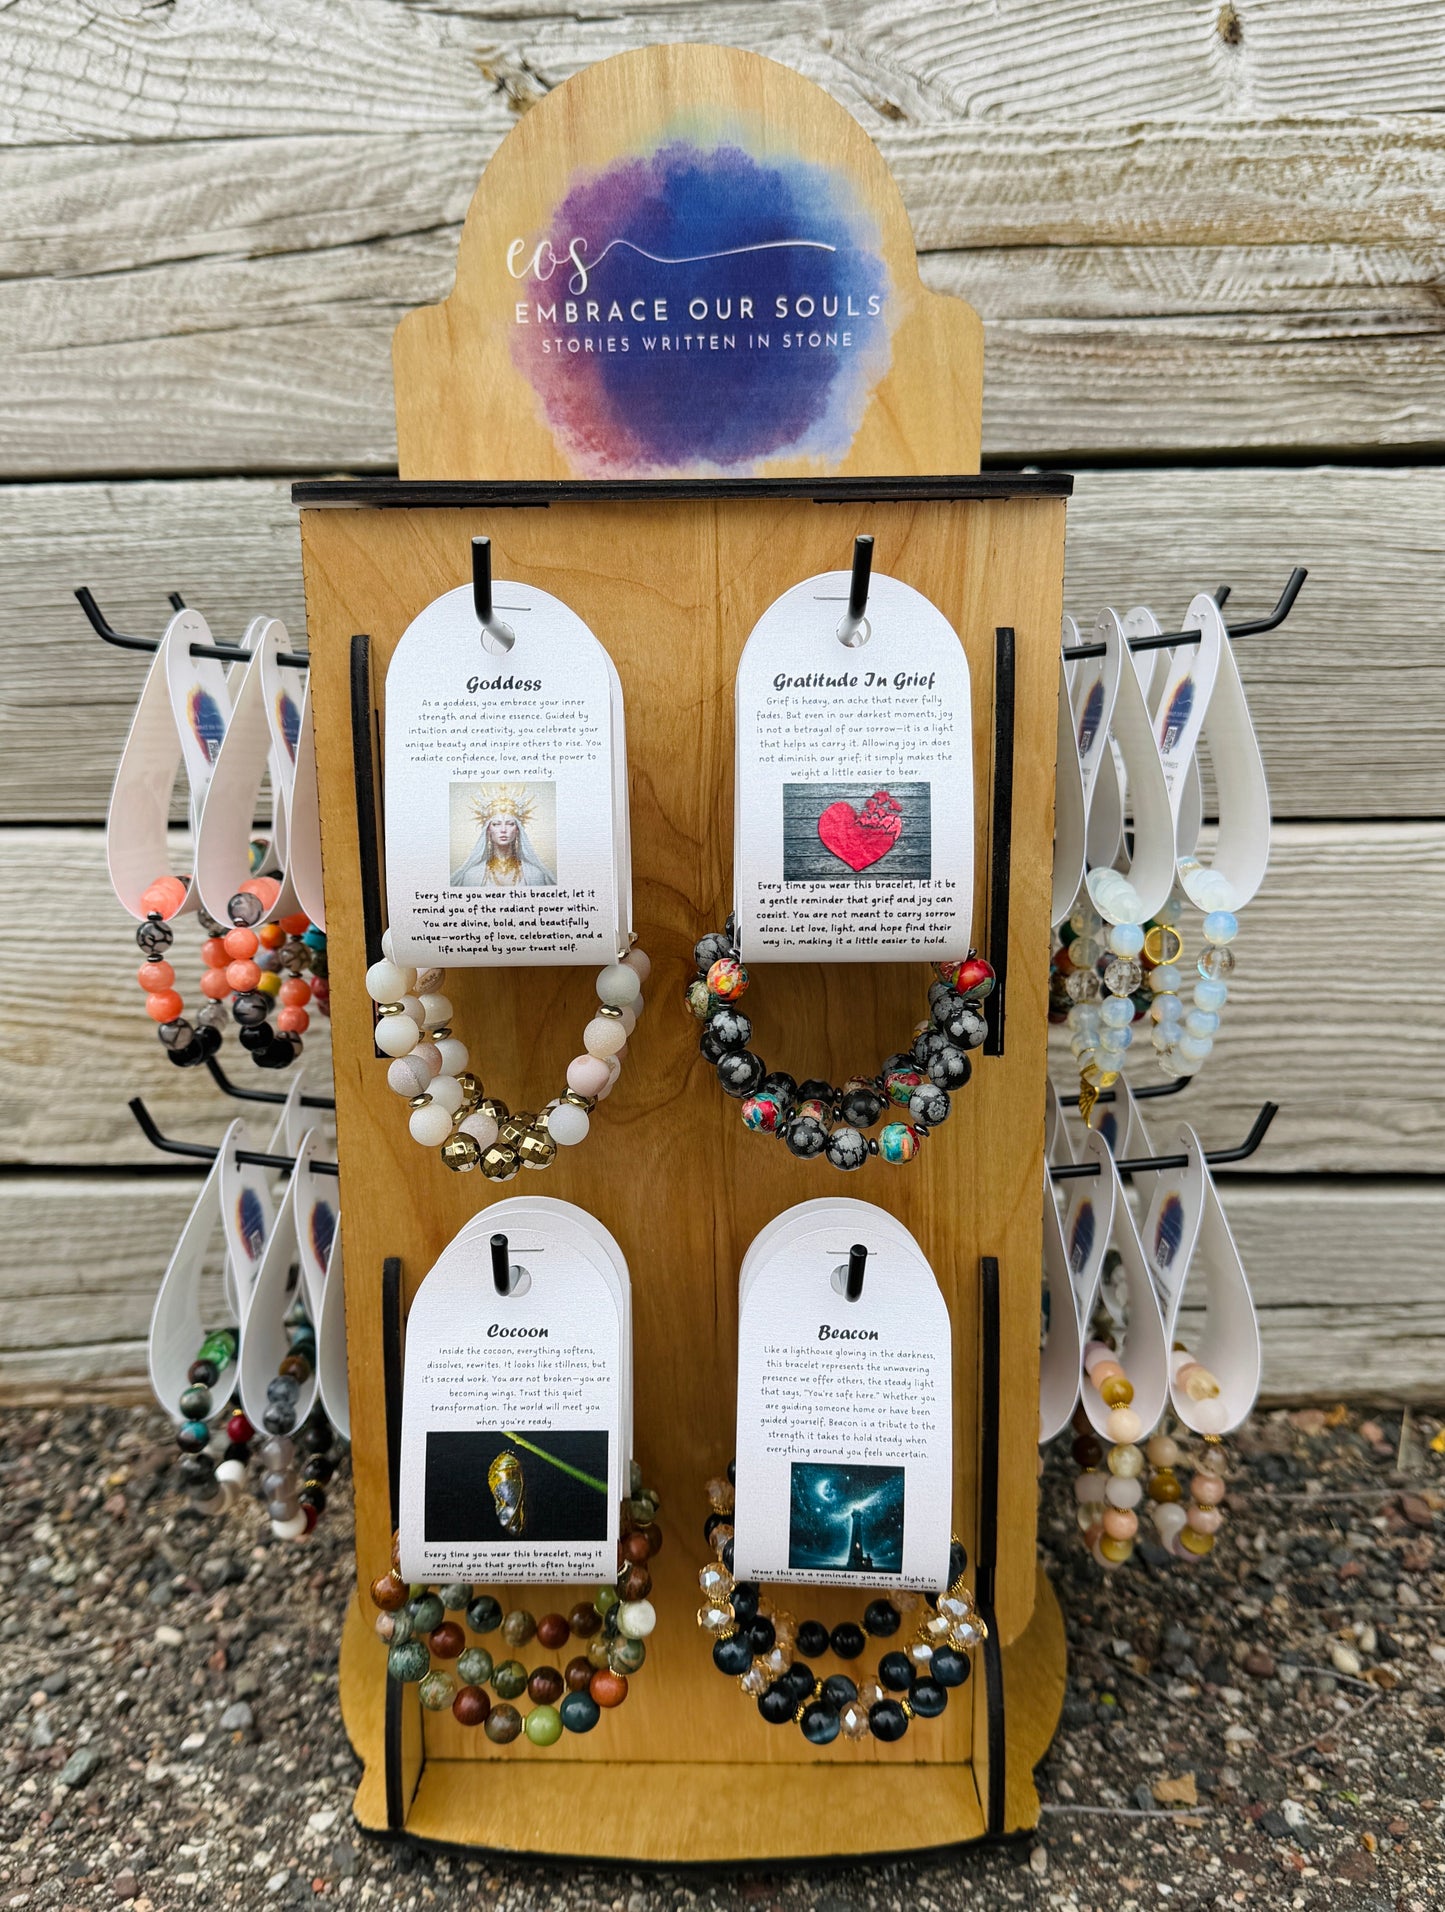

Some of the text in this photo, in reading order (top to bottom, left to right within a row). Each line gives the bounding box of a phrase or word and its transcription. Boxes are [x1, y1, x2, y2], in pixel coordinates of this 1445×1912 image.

[506, 235, 589, 296] eos
[515, 295, 881, 325] EMBRACE OUR SOULS
[542, 333, 853, 354] STORIES WRITTEN IN STONE
[466, 675, 542, 694] Goddess
[773, 672, 935, 691] Gratitude In Grief
[422, 699, 432, 707] As
[443, 698, 479, 710] goddess,
[481, 701, 497, 710] you
[500, 698, 537, 706] embrace
[539, 700, 559, 709] your
[418, 712, 457, 724] strength
[459, 712, 477, 720] and
[480, 712, 506, 720] divine
[545, 711, 575, 720] Guided
[578, 710, 589, 723] by
[756, 710, 783, 721] fades.
[786, 711, 801, 719] But
[857, 709, 891, 718] darkest
[894, 710, 937, 718] moments,
[938, 710, 953, 721] joy
[415, 891, 439, 903] Every
[442, 891, 463, 900] time
[466, 893, 482, 903] you
[509, 890, 527, 899] this
[530, 889, 570, 899] bracelet,
[572, 889, 585, 898] let
[588, 889, 595, 898] it
[769, 895, 798, 908] gentle
[801, 895, 844, 904] reminder
[846, 895, 868, 904] that
[871, 894, 895, 907] grief
[896, 895, 916, 903] and
[916, 895, 932, 907] joy
[412, 903, 599, 917] remind you of the radiant power within.
[756, 910, 790, 919] coexist.
[792, 911, 810, 919] You
[831, 910, 847, 919] not
[851, 910, 881, 918] meant
[883, 910, 894, 918] to
[897, 912, 922, 922] carry
[422, 920, 440, 928] You
[460, 919, 491, 928] divine,
[493, 918, 516, 928] bold,
[518, 918, 537, 927] and
[540, 917, 589, 929] beautifully
[759, 922, 952, 935] alone. Let love, light, and hope find their
[438, 943, 578, 955] life shaped by your truest self.
[487, 1324, 549, 1338] Cocoon
[818, 1324, 878, 1341] Beacon
[439, 1346, 464, 1355] Inside
[467, 1346, 481, 1355] the
[517, 1346, 561, 1358] everything
[764, 1345, 780, 1354] Like
[790, 1346, 833, 1358] lighthouse
[835, 1347, 867, 1360] glowing
[880, 1349, 894, 1358] the
[504, 1361, 511, 1369] It
[514, 1360, 535, 1369] looks
[538, 1360, 552, 1369] like
[592, 1359, 606, 1368] but
[766, 1359, 930, 1377] this bracelet represents the unwavering
[762, 1375, 797, 1385] presence
[812, 1374, 834, 1385] offer
[837, 1376, 865, 1386] others,
[868, 1377, 882, 1386] the
[884, 1378, 911, 1390] steady
[914, 1378, 934, 1391] light
[449, 1388, 583, 1401] becoming wings. Trust this quiet
[766, 1444, 929, 1459] everything around you feels uncertain.
[424, 1551, 447, 1561] Every
[473, 1552, 488, 1560] you
[514, 1550, 530, 1558] this
[533, 1549, 571, 1558] bracelet,
[574, 1552, 592, 1560] may
[507, 1561, 538, 1571] growth
[541, 1560, 565, 1570] often
[567, 1561, 595, 1570] begins
